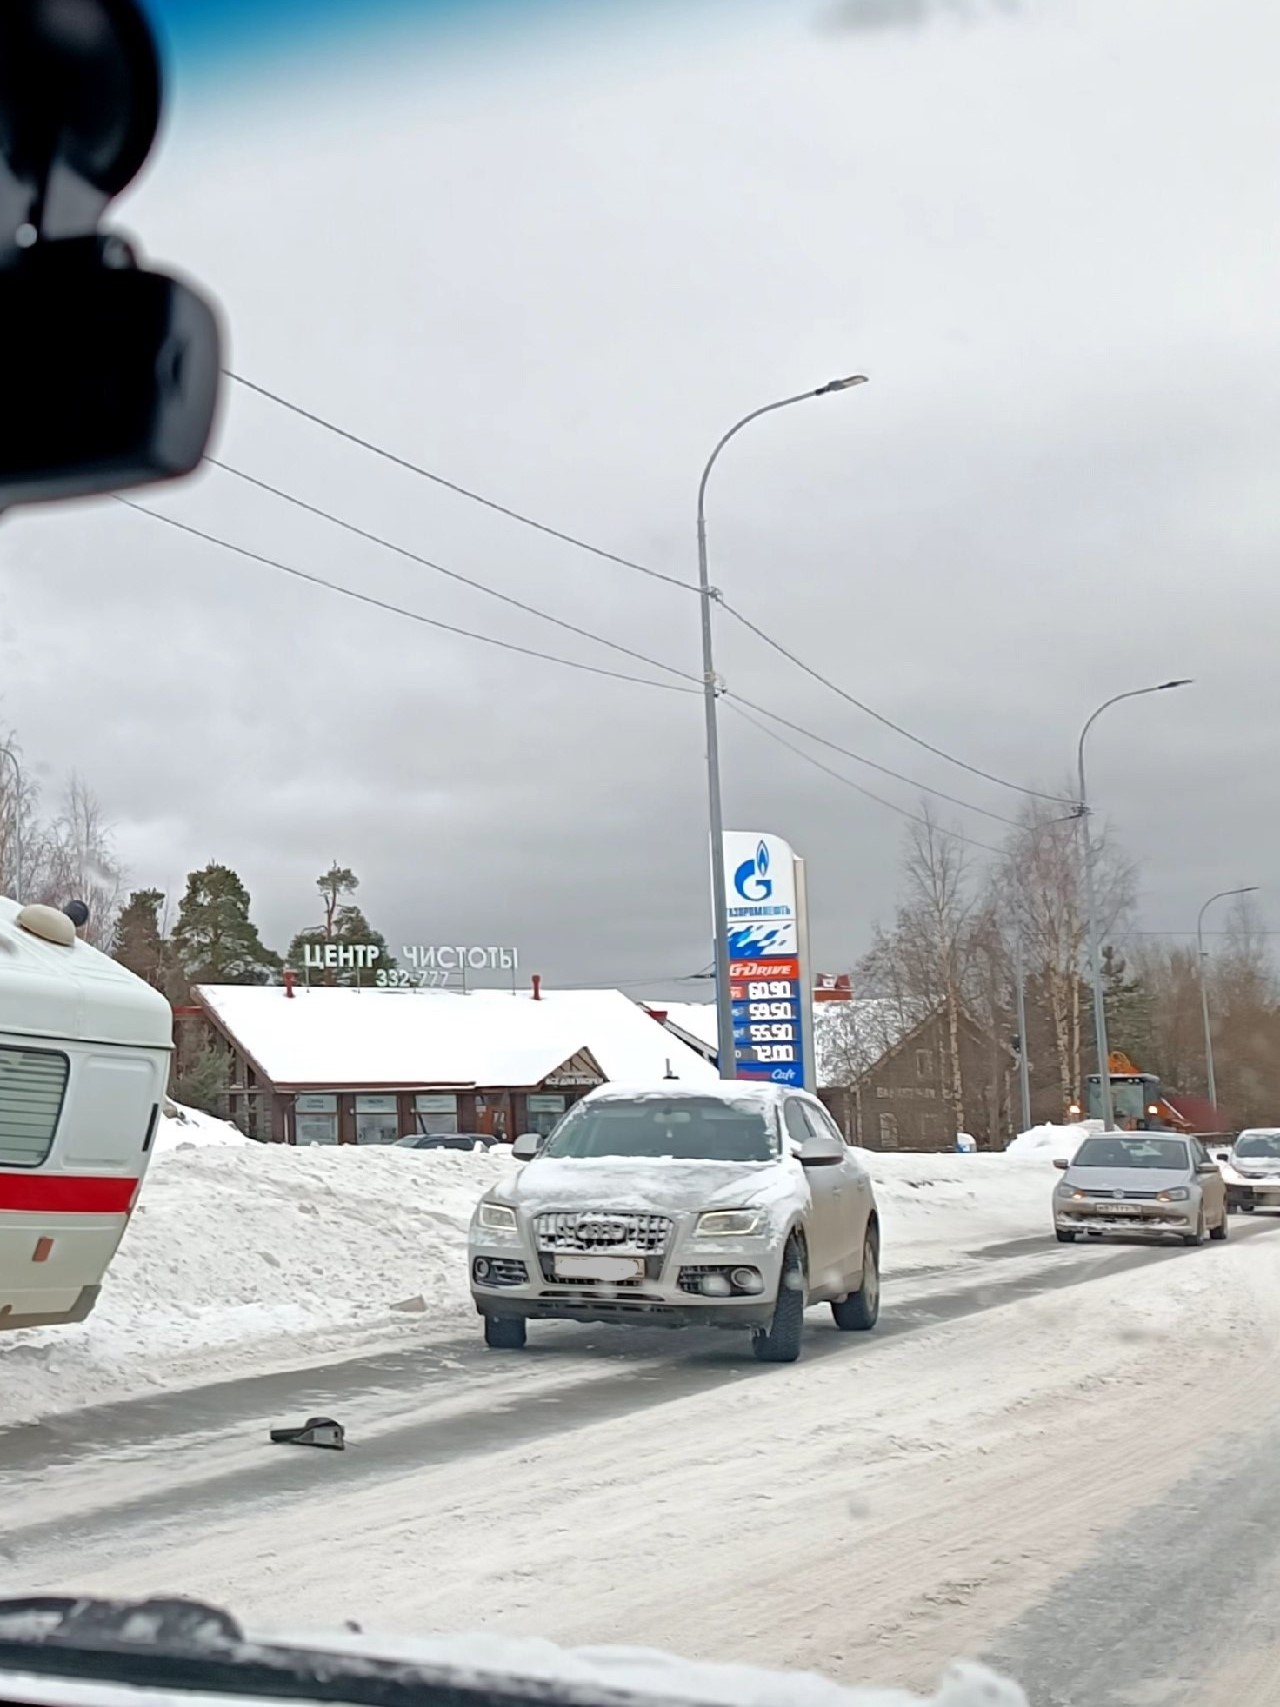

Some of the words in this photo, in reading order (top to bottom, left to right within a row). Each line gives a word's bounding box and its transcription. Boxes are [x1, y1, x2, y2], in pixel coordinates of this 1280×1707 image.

[304, 943, 380, 969] ЦЕНТР
[402, 946, 518, 969] ЧИСТОТЫ
[376, 969, 449, 988] 332-777
